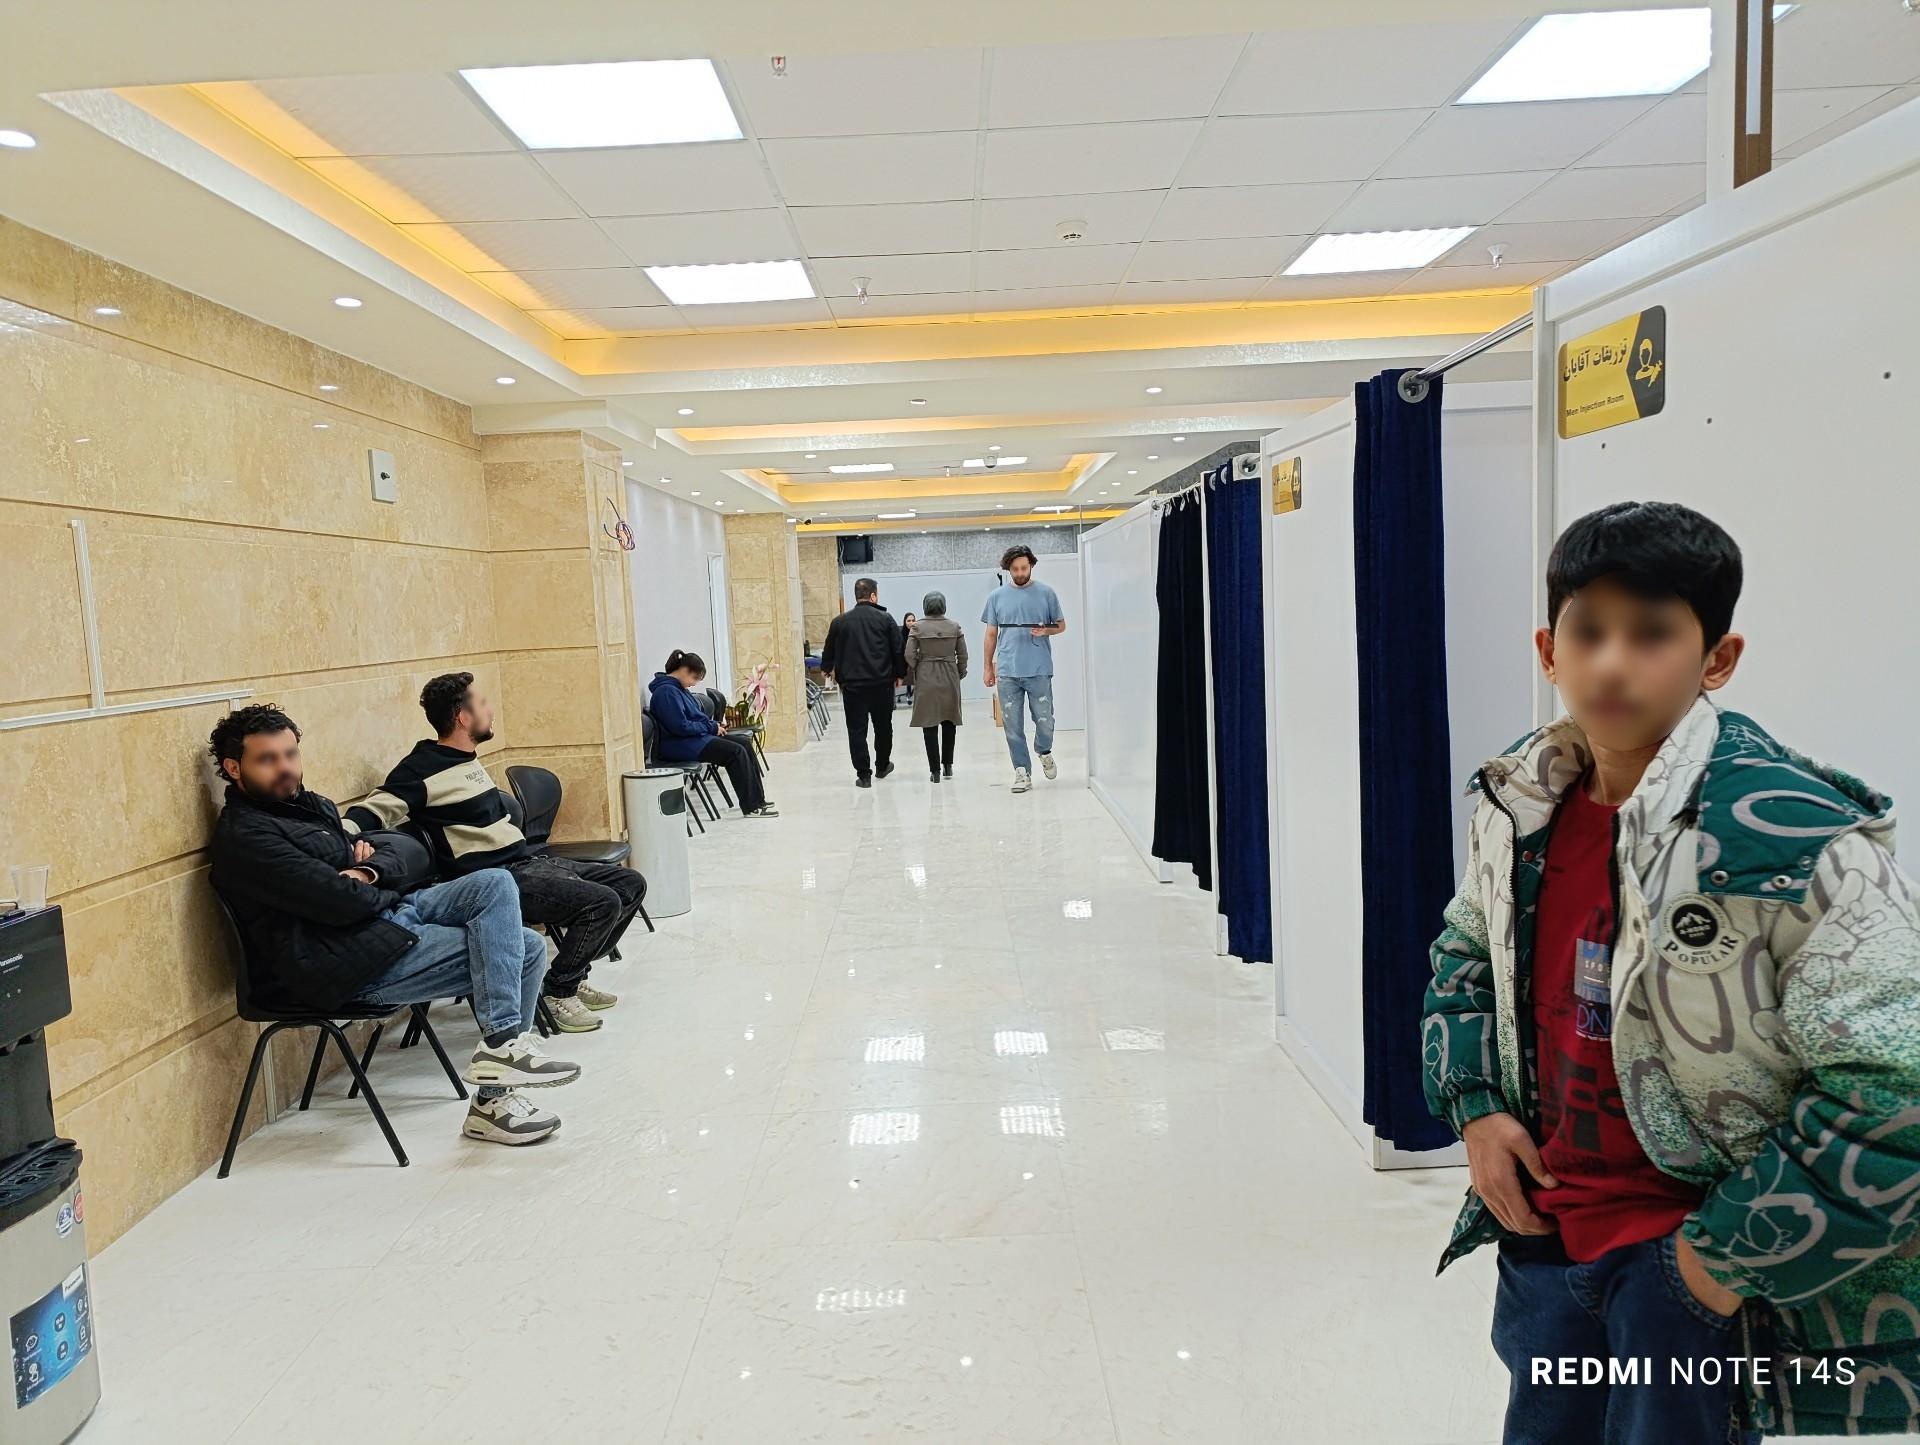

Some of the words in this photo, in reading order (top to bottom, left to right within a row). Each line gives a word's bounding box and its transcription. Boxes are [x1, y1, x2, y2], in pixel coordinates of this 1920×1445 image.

[1563, 349, 1590, 382] آقایان
[1566, 408, 1578, 417] Men
[1580, 399, 1606, 414] Injection
[1607, 394, 1625, 405] Room
[0, 953, 24, 967] anasonic
